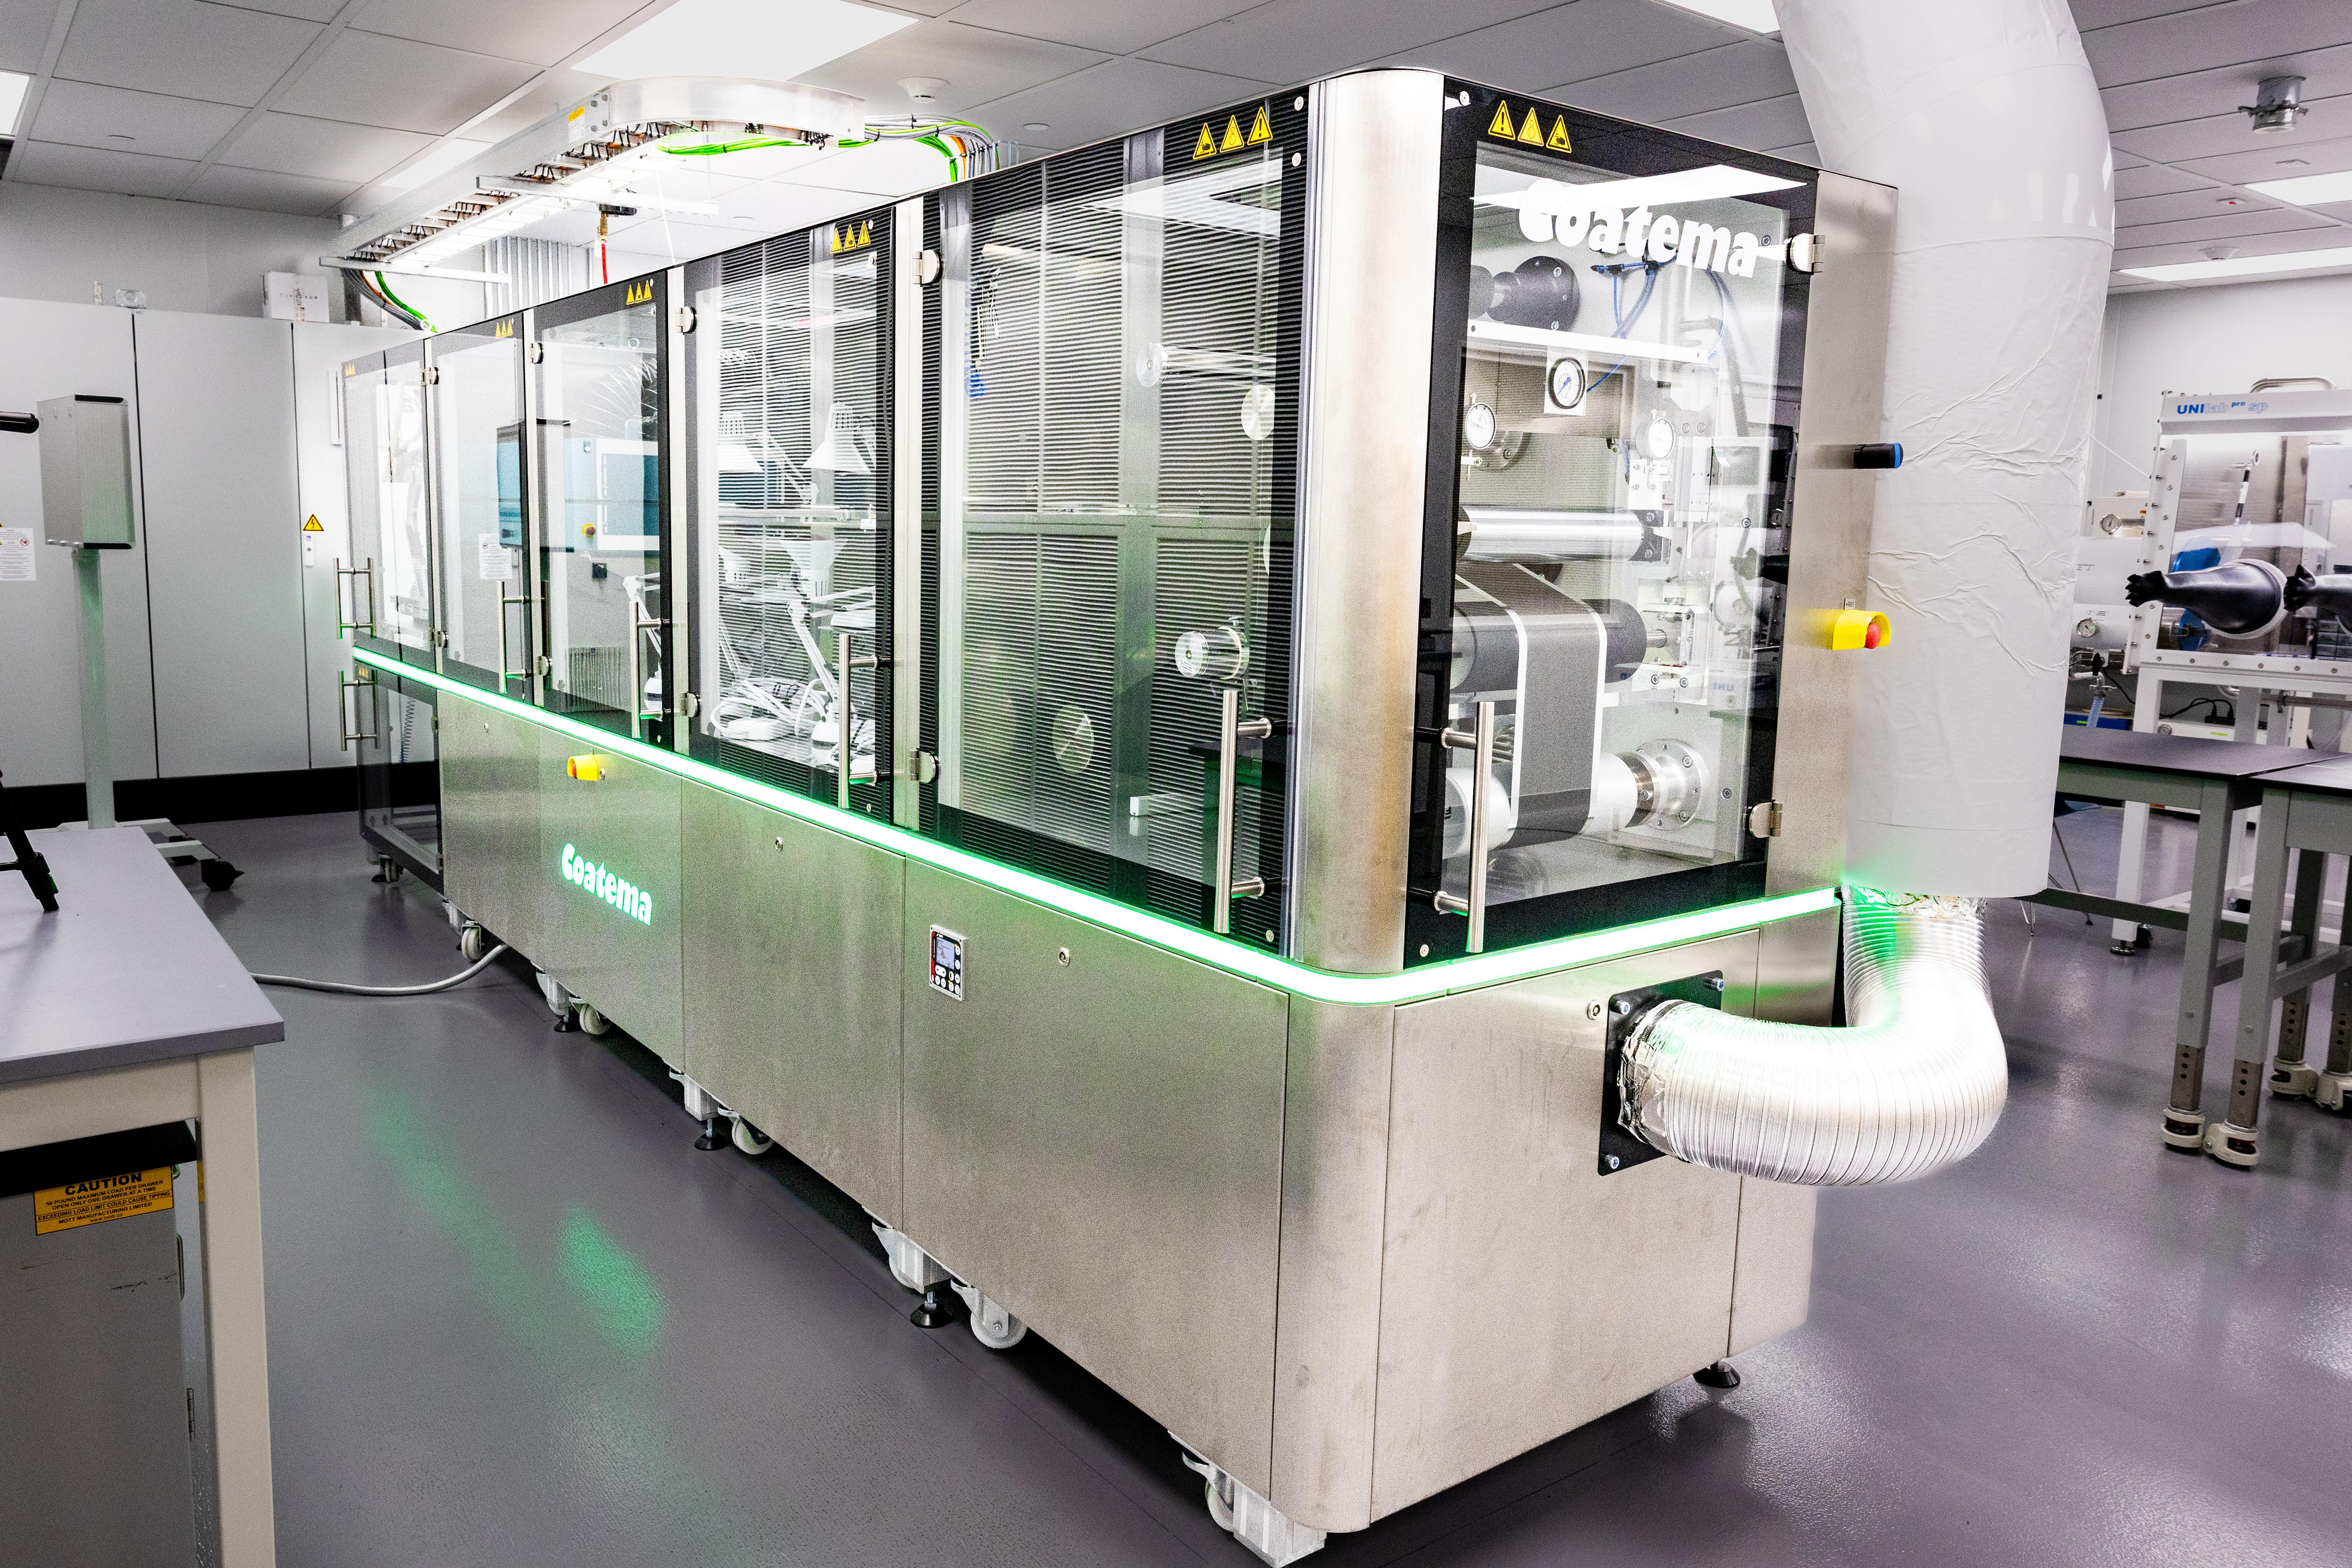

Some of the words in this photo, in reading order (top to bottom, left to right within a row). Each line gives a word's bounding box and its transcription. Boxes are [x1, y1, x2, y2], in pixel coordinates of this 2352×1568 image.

[1519, 178, 1758, 278] Coatema
[2177, 403, 2229, 414] UNIlab
[2248, 403, 2268, 413] sp
[561, 842, 652, 926] Coatema
[65, 1172, 142, 1195] CAUTION
[77, 1191, 106, 1200] MAXIMUM
[102, 1192, 128, 1200] DRAWER
[38, 1211, 72, 1220] EXCEEDING
[77, 1207, 128, 1220] MANUFACTURING
[90, 1213, 123, 1222] www.mott.ca
